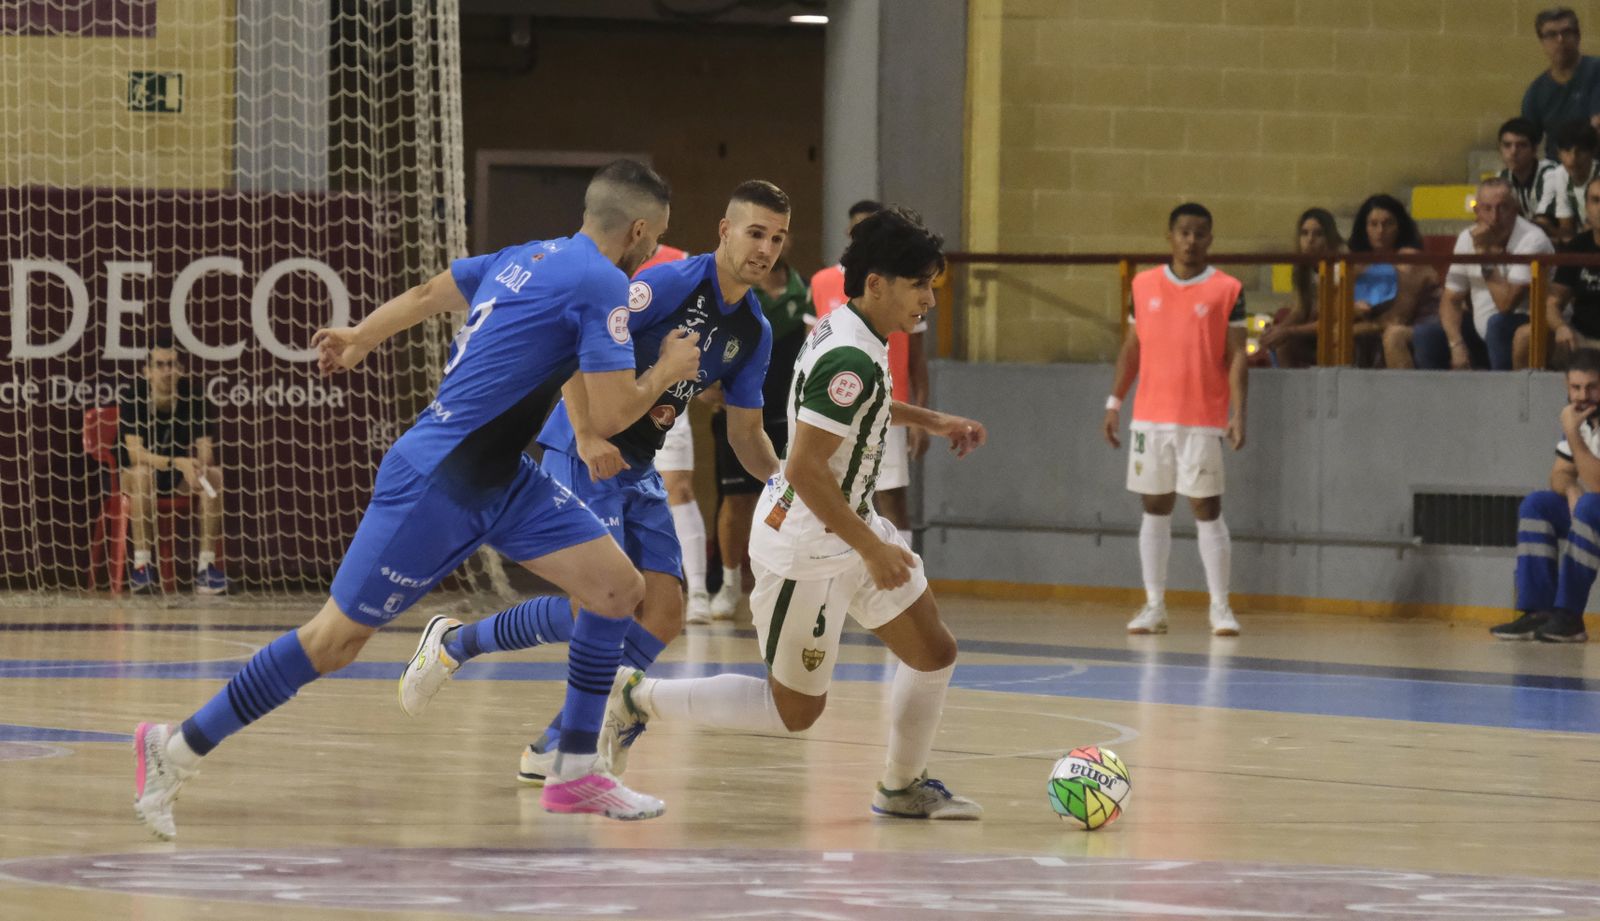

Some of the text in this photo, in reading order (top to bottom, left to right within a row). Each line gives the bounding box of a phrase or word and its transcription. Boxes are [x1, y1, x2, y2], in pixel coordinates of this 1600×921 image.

[7, 256, 350, 362] DECO
[703, 326, 718, 352] 6
[207, 376, 345, 408] Córdoba
[812, 603, 826, 638] 5
[1070, 763, 1118, 790] Joma
